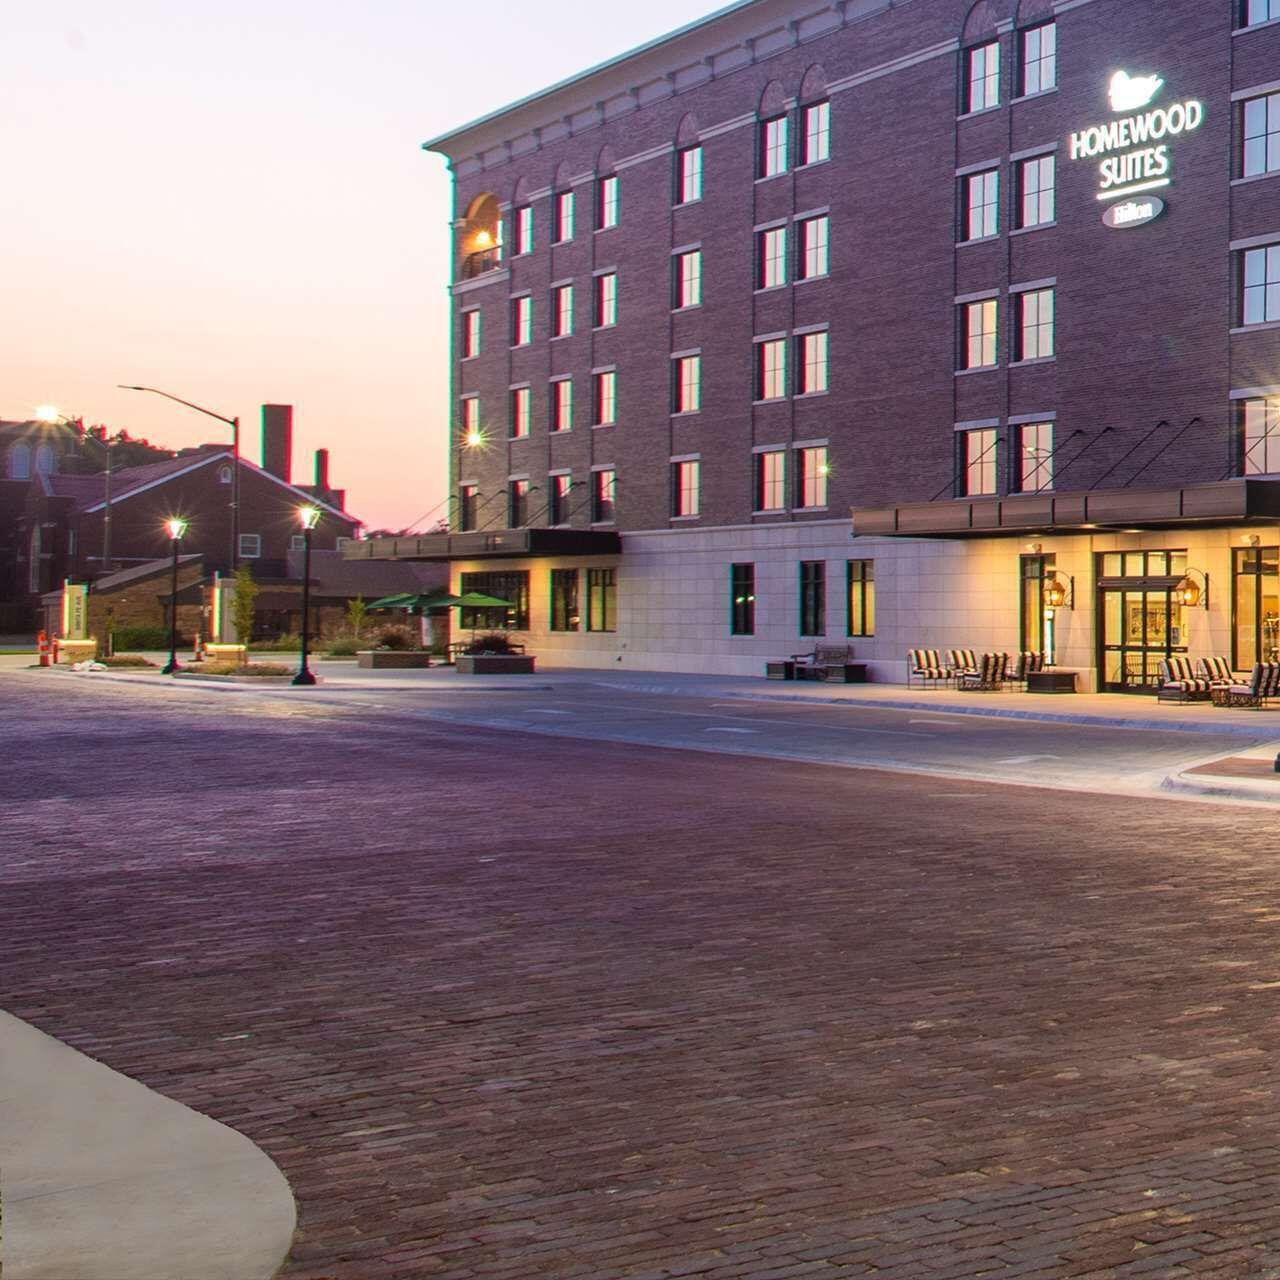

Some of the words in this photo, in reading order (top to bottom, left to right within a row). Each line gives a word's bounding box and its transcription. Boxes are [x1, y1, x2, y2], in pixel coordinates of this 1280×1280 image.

[1070, 100, 1202, 160] HOMEWOOD
[1100, 144, 1170, 189] SUITES
[1113, 202, 1153, 224] Hilton
